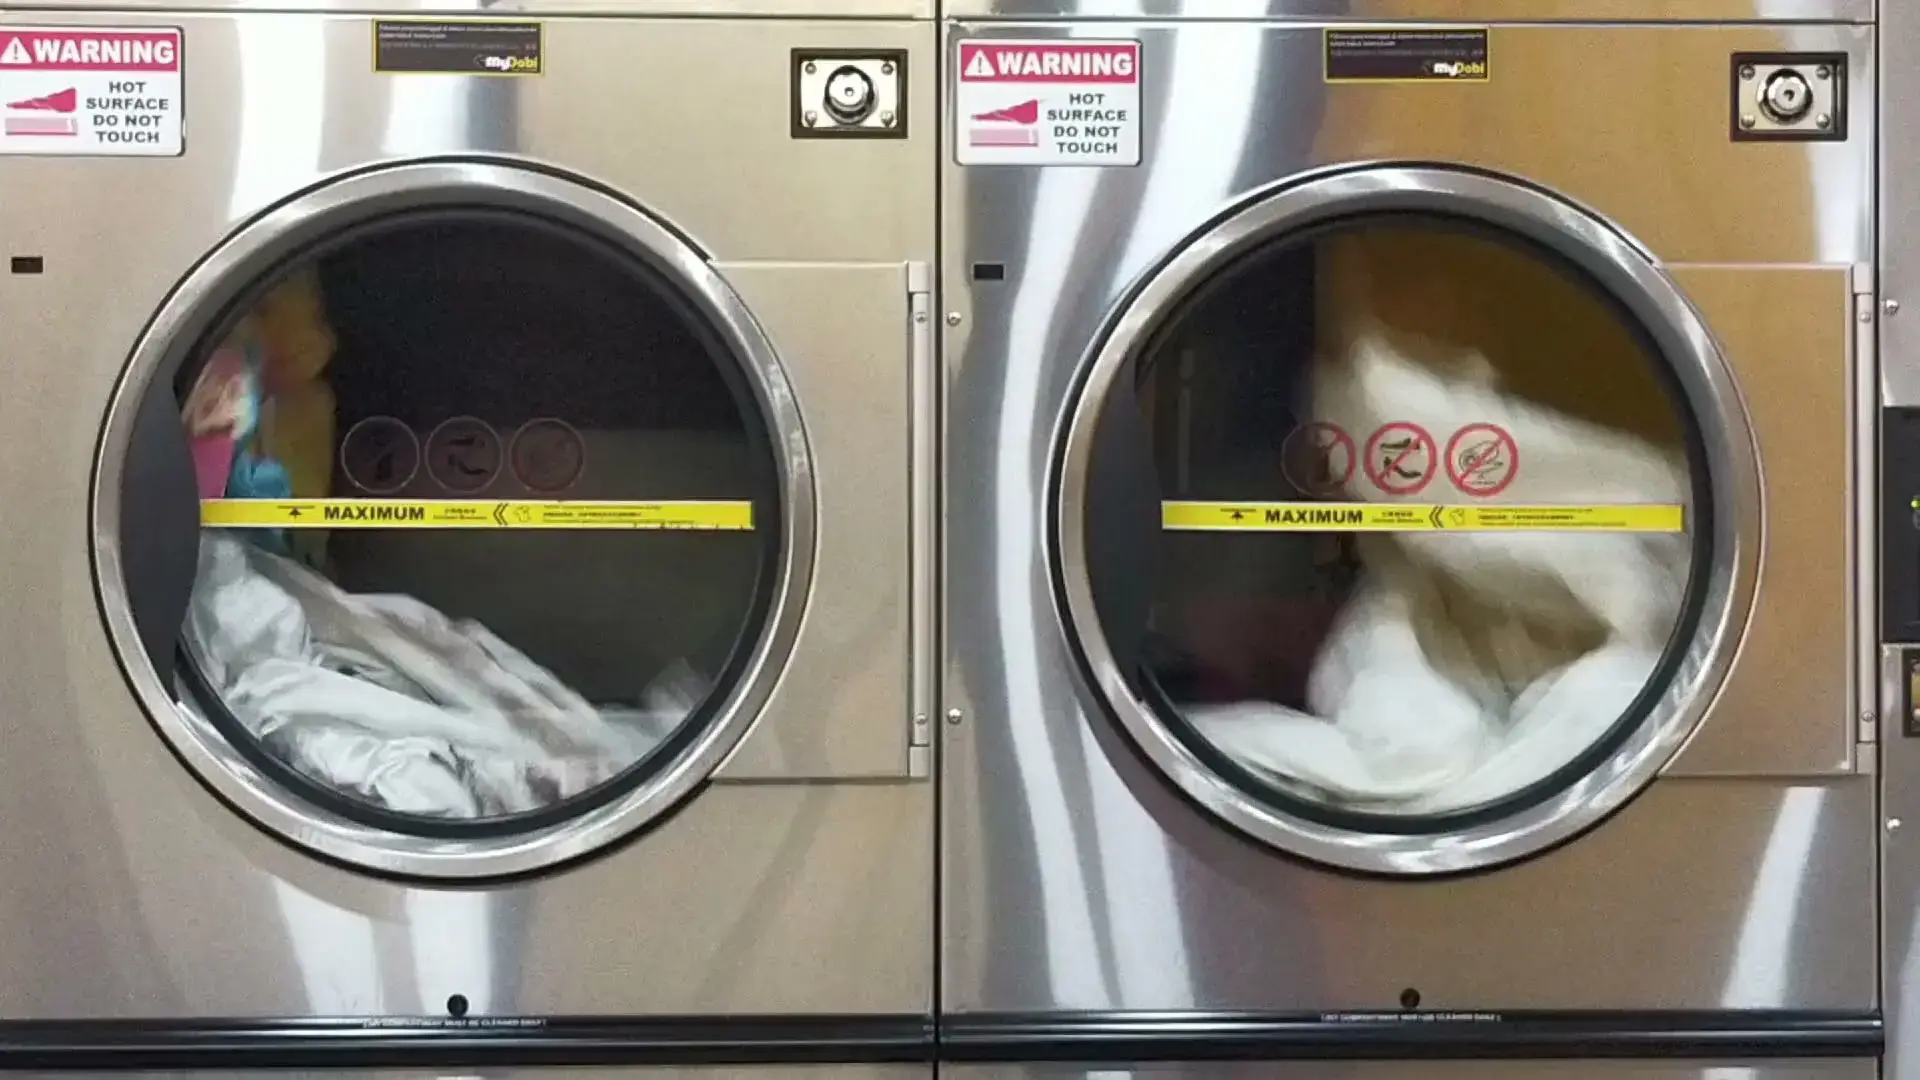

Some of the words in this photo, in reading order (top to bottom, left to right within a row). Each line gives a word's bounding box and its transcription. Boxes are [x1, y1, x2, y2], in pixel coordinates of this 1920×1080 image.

[33, 39, 174, 64] WARNING
[996, 51, 1133, 76] WARNING
[108, 81, 147, 93] HOT
[86, 98, 169, 110] SURFACE
[1069, 93, 1106, 105] HOT
[93, 115, 118, 126] DO
[125, 115, 162, 127] NOT
[1046, 109, 1127, 121] SURFACE
[96, 131, 160, 143] TOUCH
[1054, 126, 1078, 137] DO
[1085, 126, 1121, 137] NOT
[1056, 142, 1119, 153] TOUCH
[324, 506, 425, 520] MAXIMUM
[1265, 509, 1363, 524] MAXIMUM
